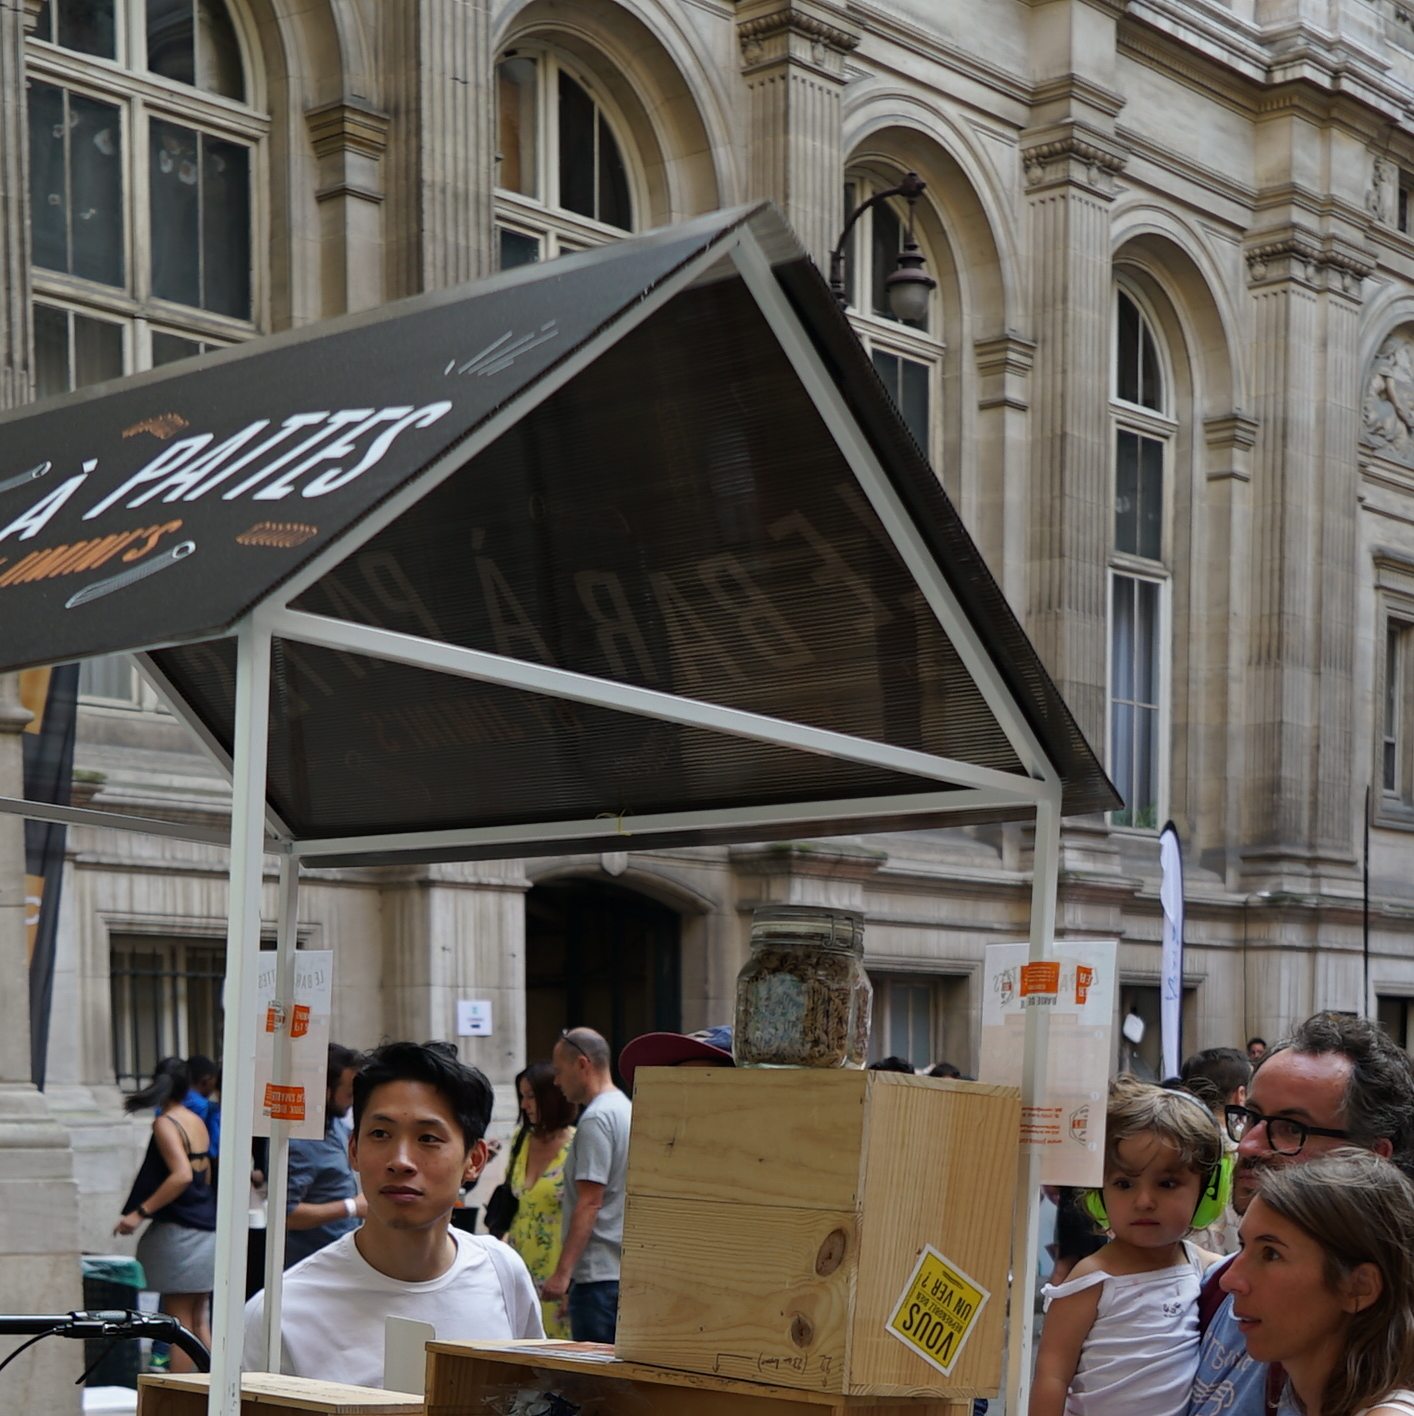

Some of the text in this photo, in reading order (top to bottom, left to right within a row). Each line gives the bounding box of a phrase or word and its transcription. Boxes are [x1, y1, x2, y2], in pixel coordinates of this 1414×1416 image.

[81, 401, 453, 521] PATTES
[931, 1278, 955, 1307] VER
[953, 1296, 973, 1321] UN
[902, 1303, 955, 1362] VOUS
